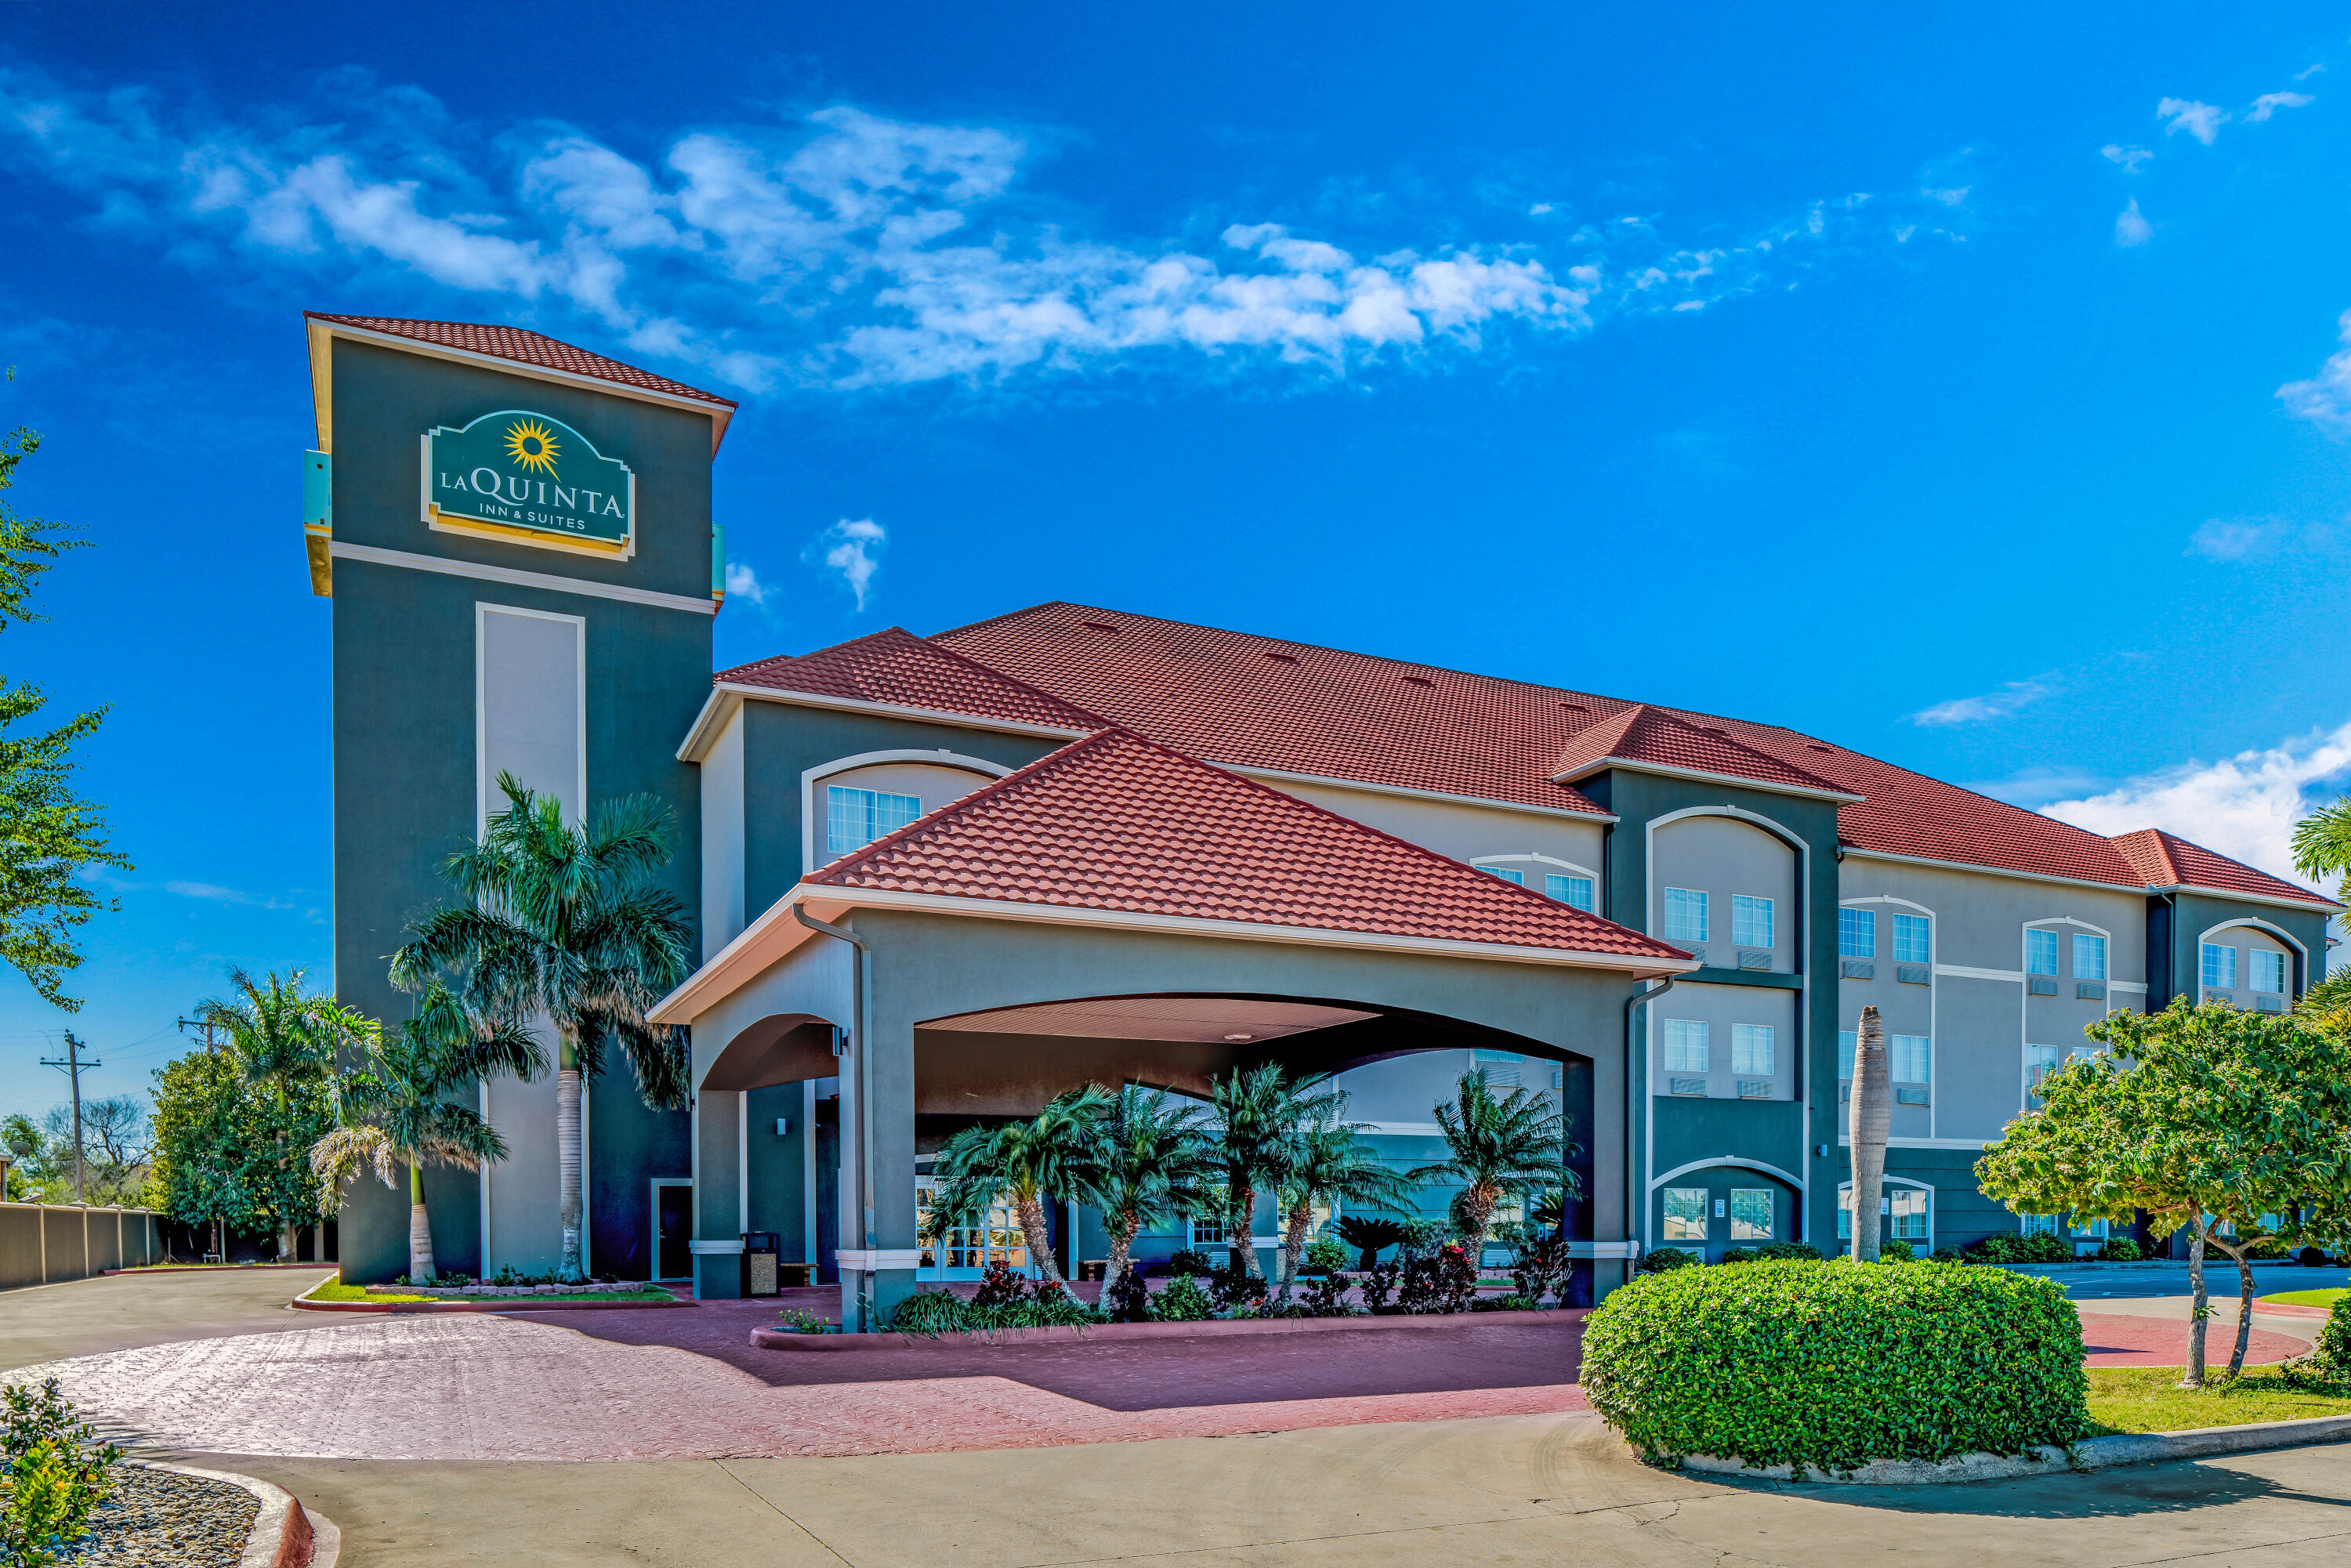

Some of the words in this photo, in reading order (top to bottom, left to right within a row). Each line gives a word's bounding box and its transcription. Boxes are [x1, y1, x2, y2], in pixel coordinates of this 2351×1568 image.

[440, 472, 469, 491] LA
[470, 467, 625, 519] QUINTA
[480, 503, 508, 517] INN
[514, 510, 521, 520] &
[527, 512, 585, 530] SUITES
